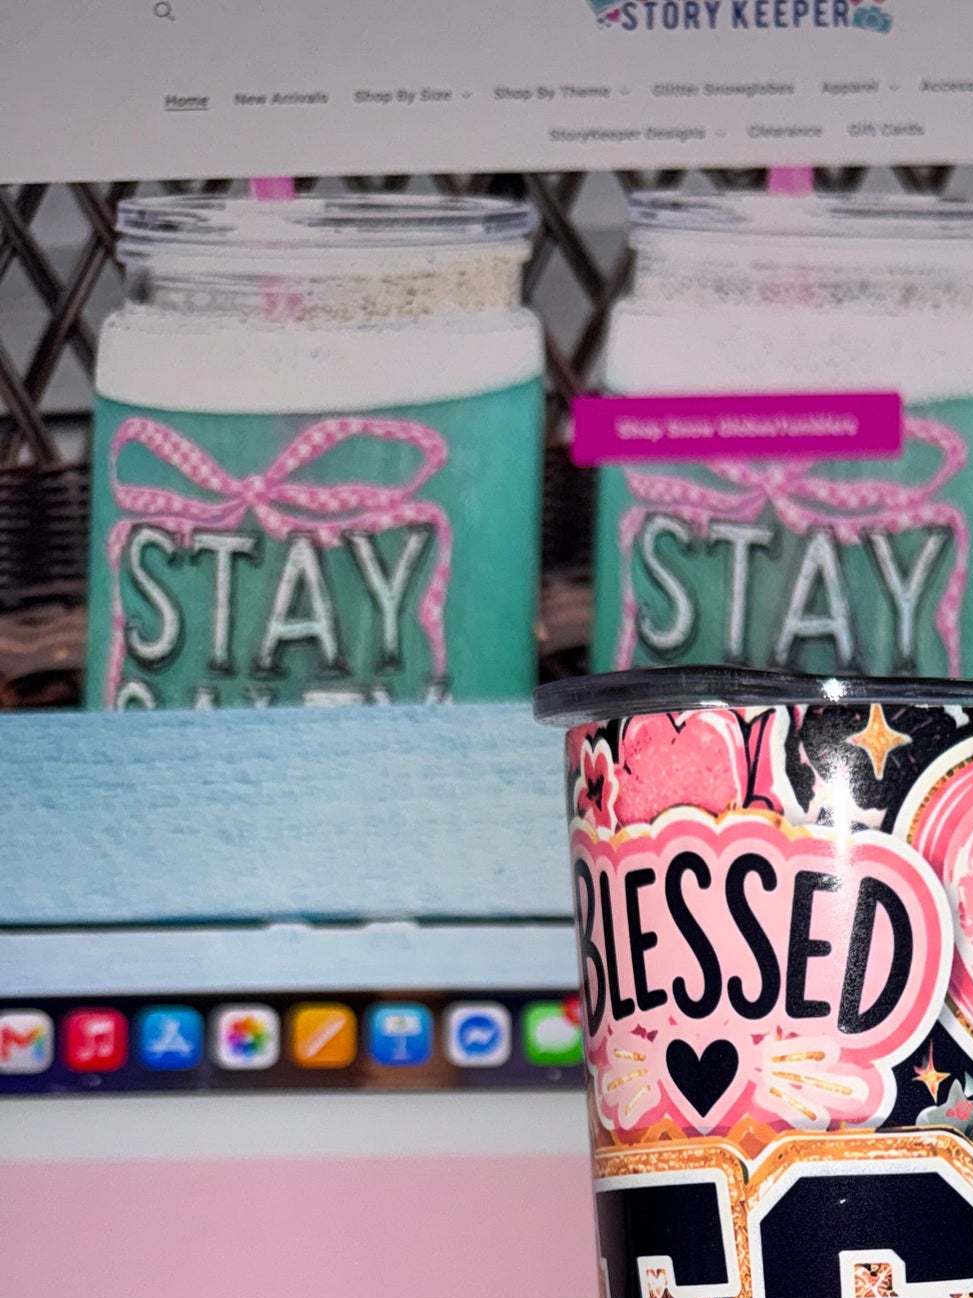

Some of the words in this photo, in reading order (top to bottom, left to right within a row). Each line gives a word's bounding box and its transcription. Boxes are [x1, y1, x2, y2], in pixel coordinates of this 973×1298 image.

[621, 1, 718, 30] STORY
[731, 0, 849, 29] KEEPER
[164, 94, 209, 108] Home
[234, 92, 267, 105] New
[270, 91, 328, 104] Arrivals
[353, 88, 393, 104] Shop
[396, 87, 416, 104] By
[420, 87, 452, 102] Size
[494, 86, 533, 101] Shop
[536, 86, 555, 100] By
[560, 85, 610, 98] Theme
[847, 121, 876, 136] Gift
[881, 121, 924, 136] Cards
[640, 514, 952, 671] STAY
[126, 526, 430, 677] STAY
[573, 851, 914, 1038] BLESSED
